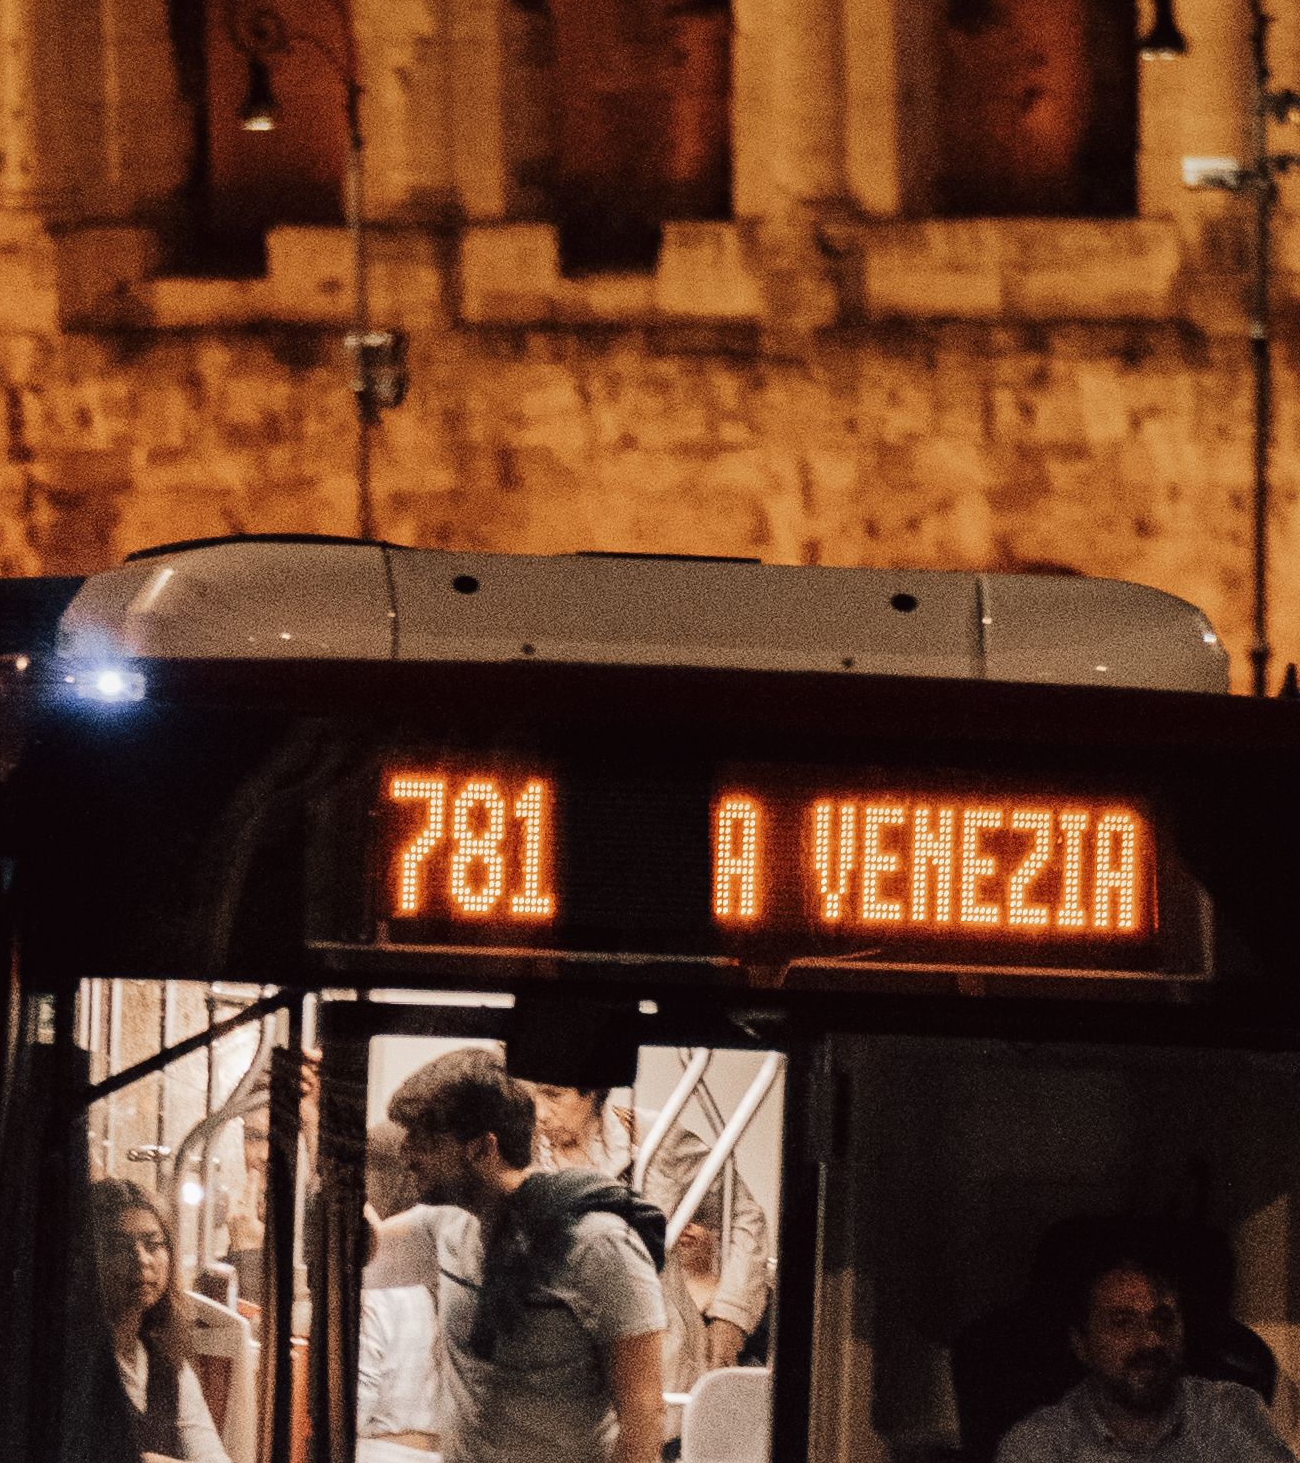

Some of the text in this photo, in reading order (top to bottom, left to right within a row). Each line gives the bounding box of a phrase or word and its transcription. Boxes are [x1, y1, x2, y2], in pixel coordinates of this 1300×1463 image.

[386, 776, 1139, 930] 781 A VENEZIA
